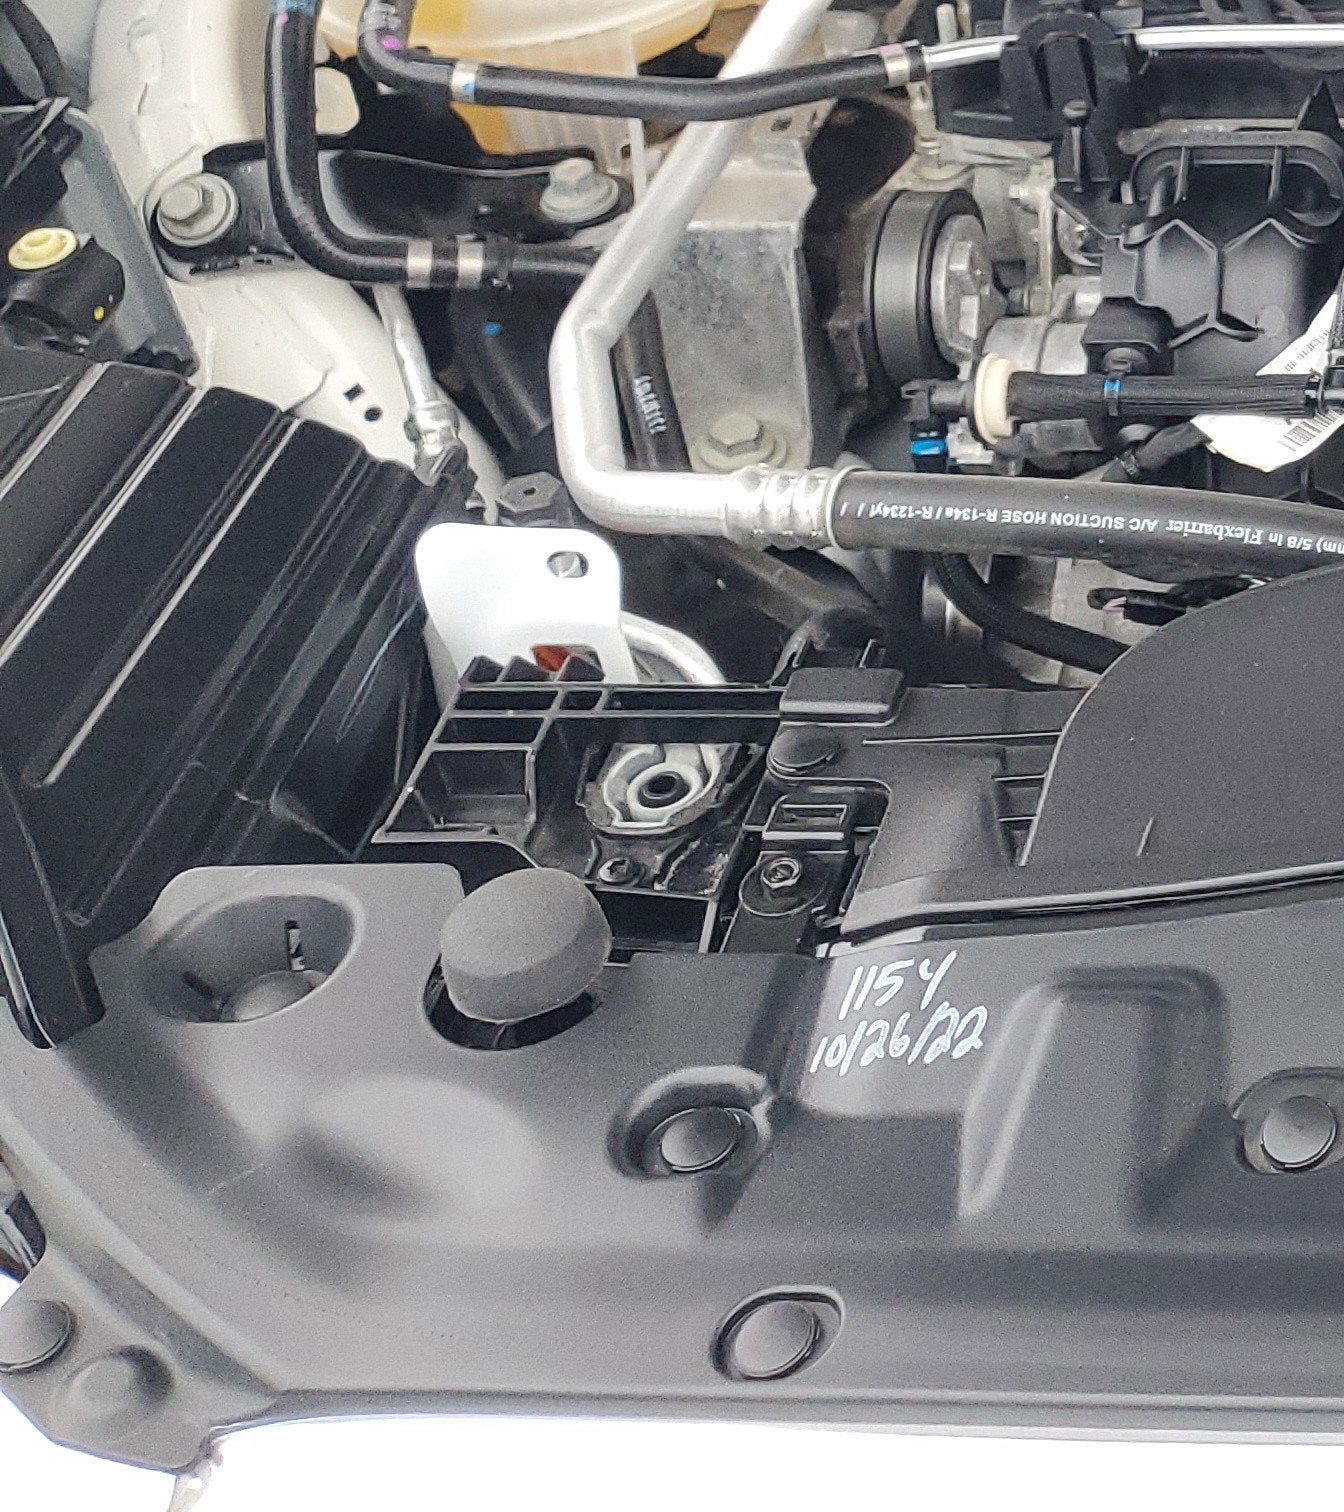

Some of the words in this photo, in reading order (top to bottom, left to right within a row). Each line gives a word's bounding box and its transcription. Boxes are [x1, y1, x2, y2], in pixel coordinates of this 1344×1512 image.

[945, 507, 997, 522] R-134a
[1001, 509, 1047, 525] HOSE
[1050, 512, 1124, 529] SUCTION
[1129, 519, 1158, 532] A/C
[1166, 520, 1264, 545] Flexbarrier
[1287, 536, 1313, 550] 5/8
[809, 1001, 988, 1077] 10/26/22
